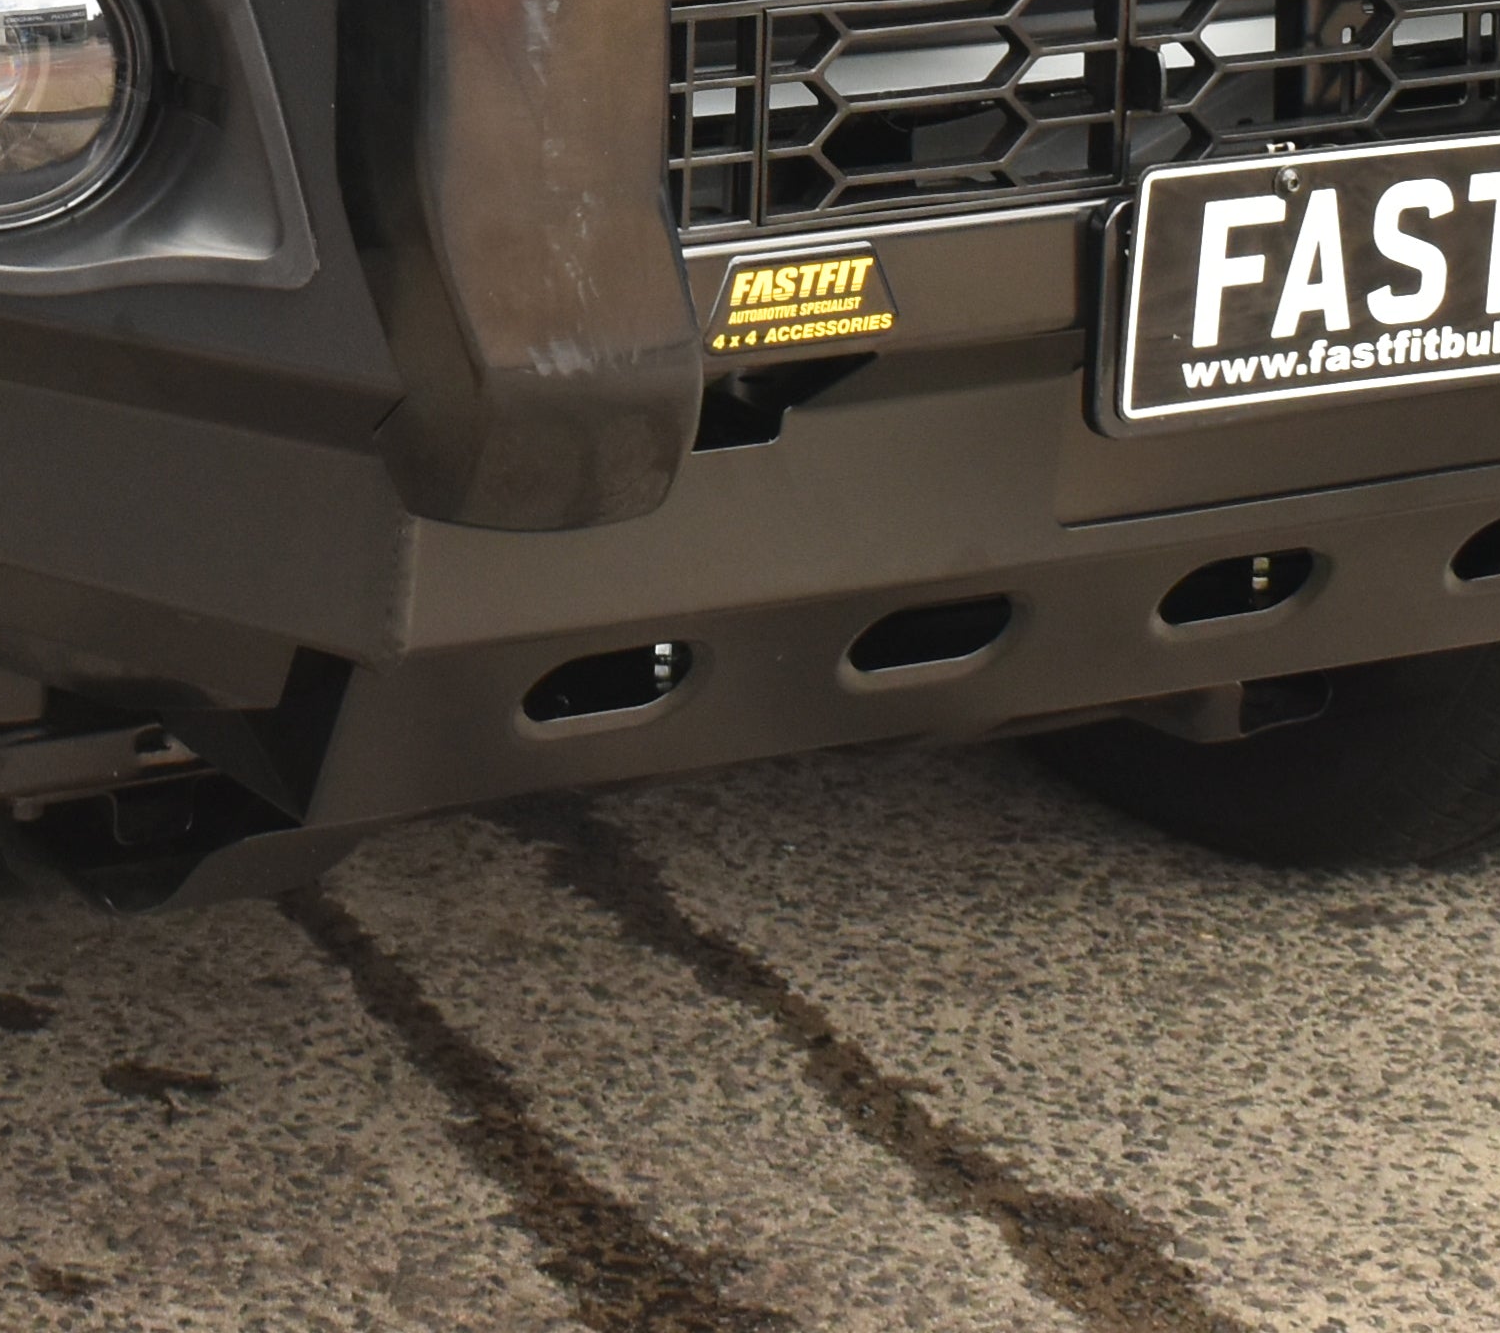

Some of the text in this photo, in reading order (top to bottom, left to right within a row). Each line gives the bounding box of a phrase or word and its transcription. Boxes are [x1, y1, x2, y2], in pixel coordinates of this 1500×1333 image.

[729, 257, 874, 306] FASTFIT
[728, 296, 862, 325] AUTOMOTIVE SPECIALIST
[712, 334, 726, 350] 4
[744, 330, 758, 346] 4
[763, 312, 894, 344] ACCESSORIES
